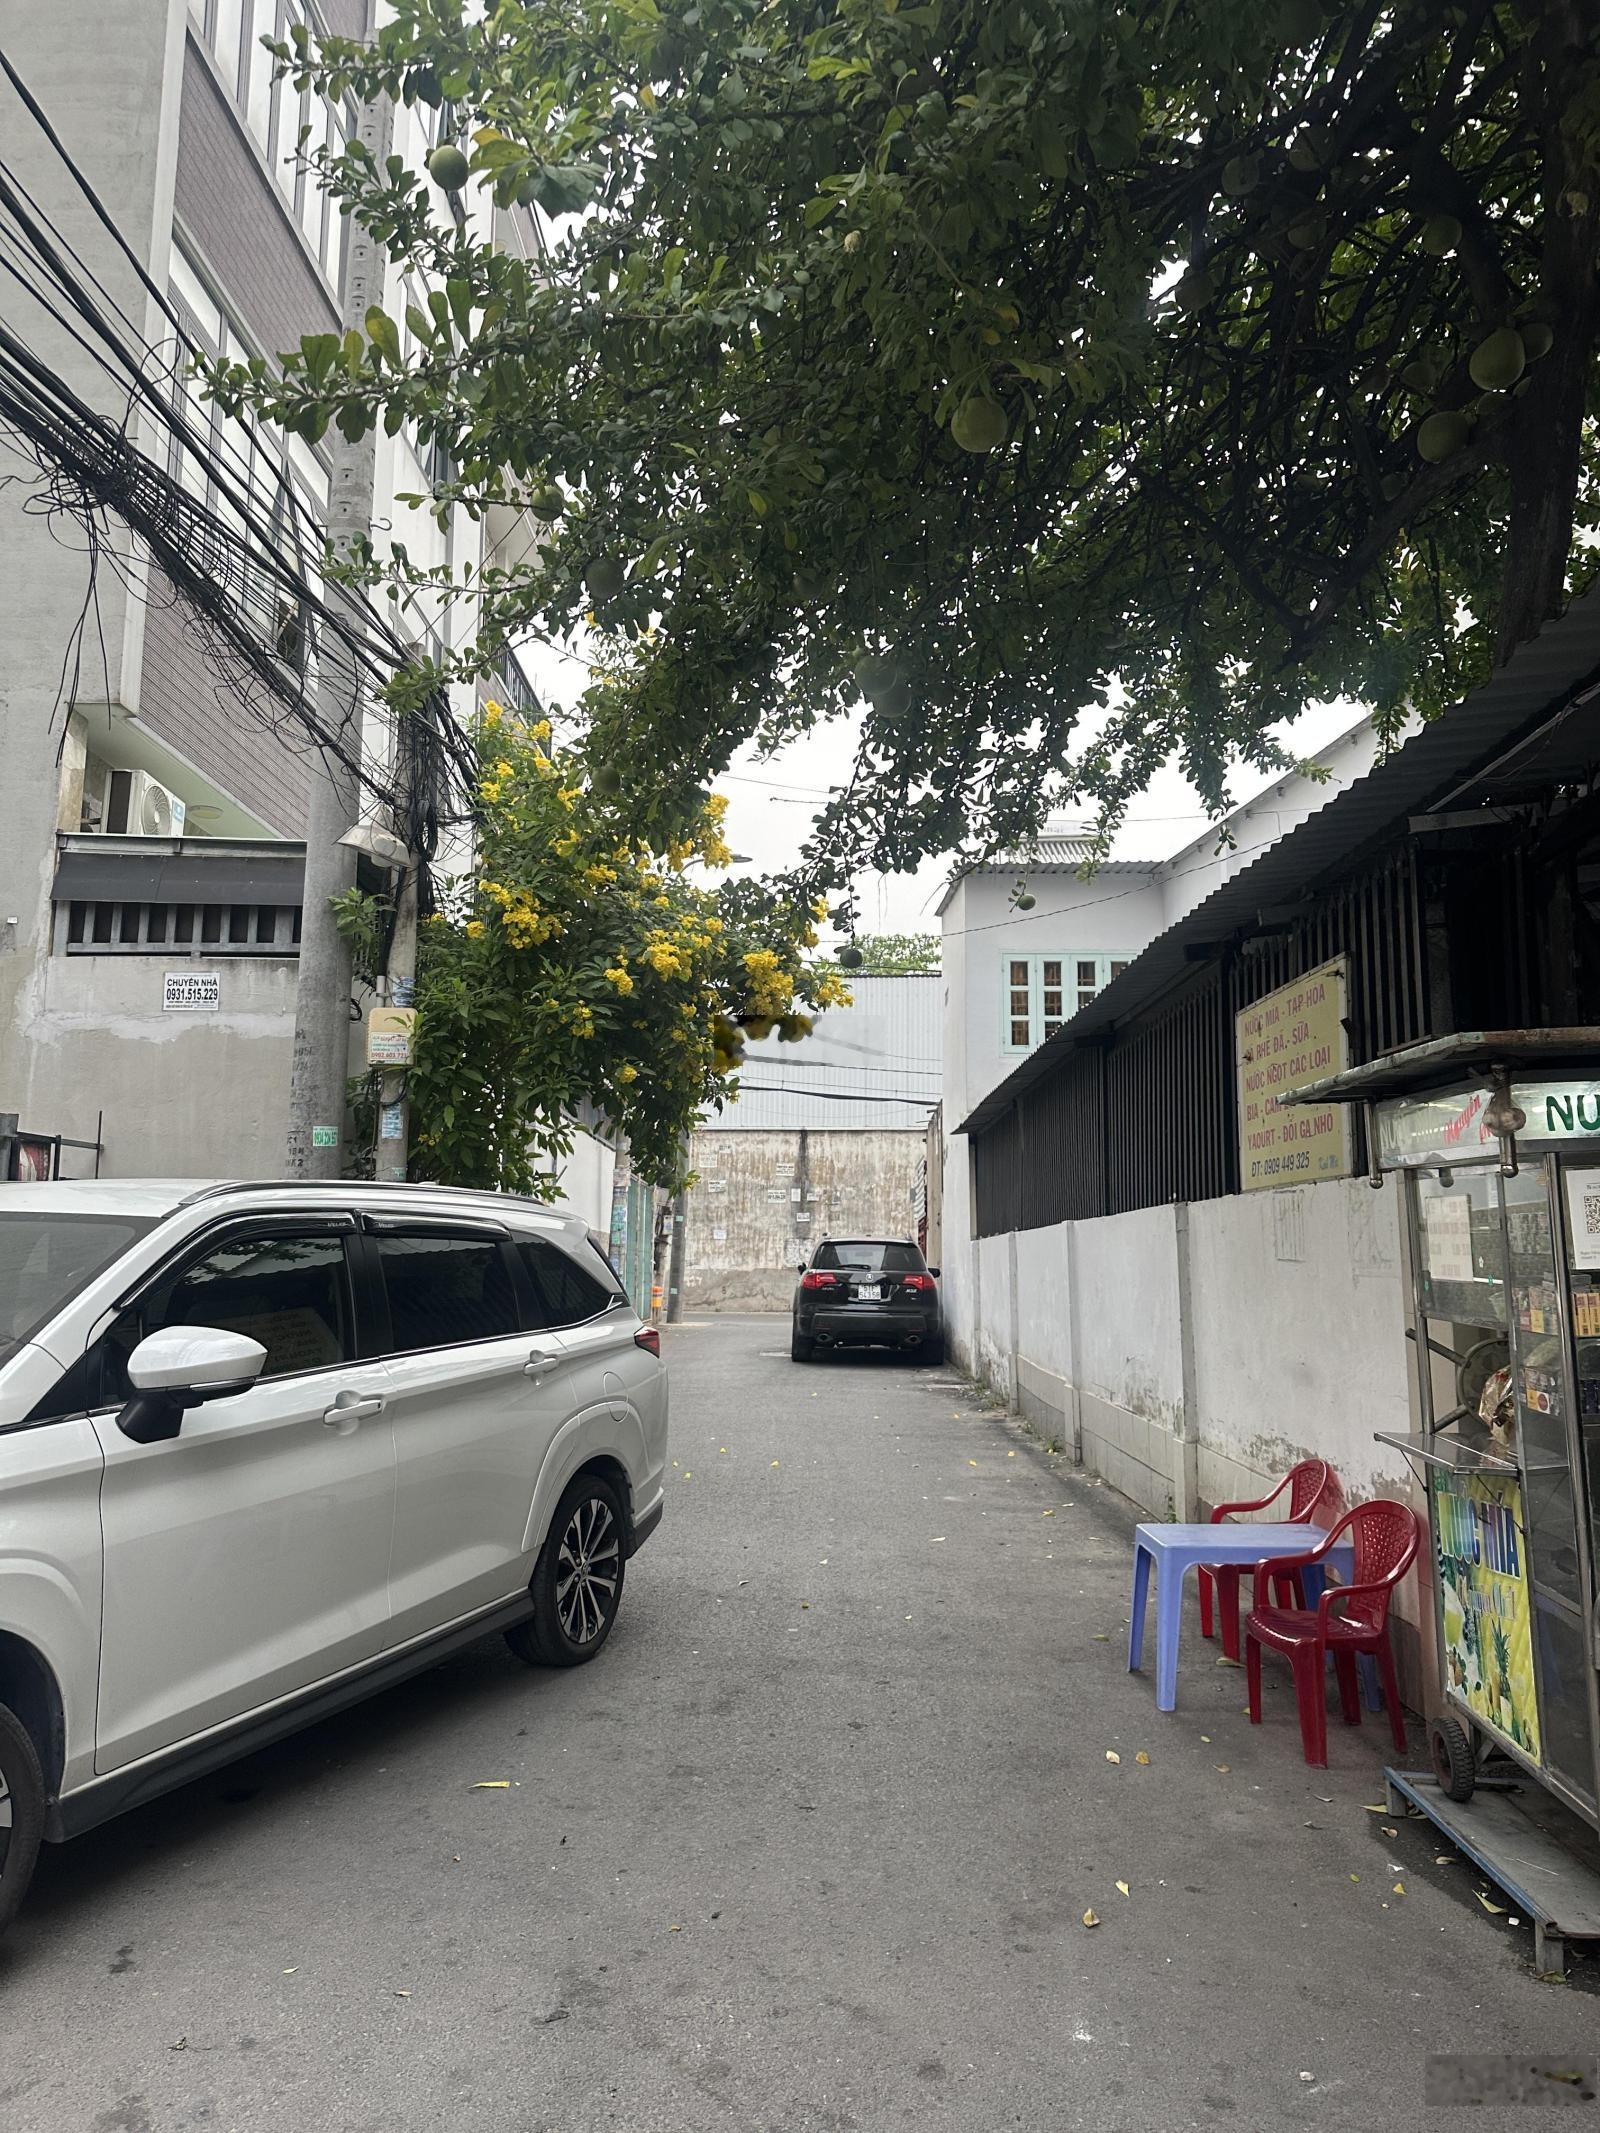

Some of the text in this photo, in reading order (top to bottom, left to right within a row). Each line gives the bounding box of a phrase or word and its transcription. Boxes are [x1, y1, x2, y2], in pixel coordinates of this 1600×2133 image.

[166, 987, 218, 1001] 0931.515.229
[1281, 1154, 1295, 1171] 449
[1296, 1150, 1311, 1169] 325
[1480, 1490, 1521, 1580] MÍA
